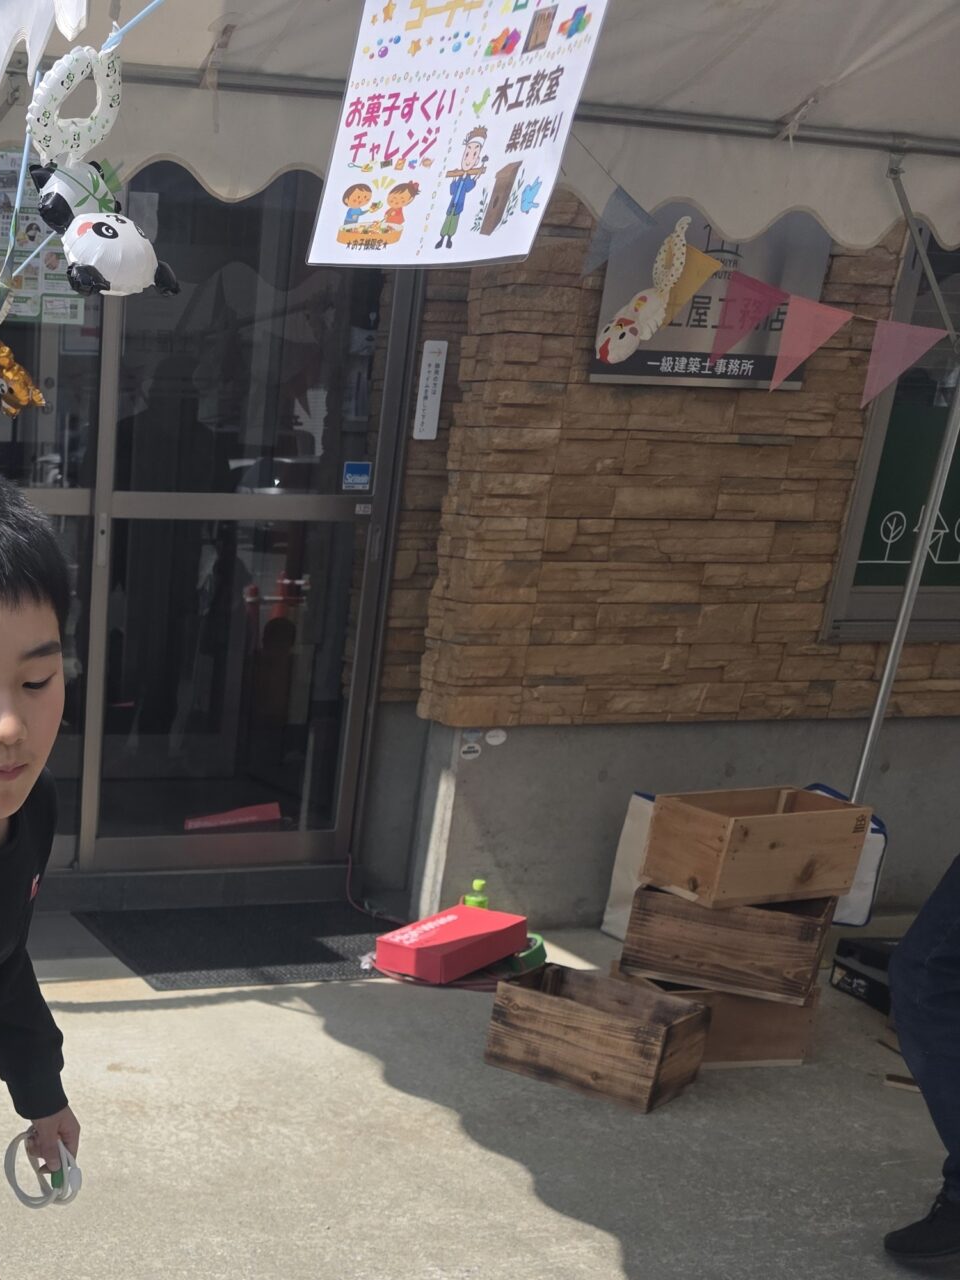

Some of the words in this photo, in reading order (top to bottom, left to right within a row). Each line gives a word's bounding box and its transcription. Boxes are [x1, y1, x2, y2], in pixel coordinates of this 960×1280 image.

[345, 88, 456, 129] お菓子すくい
[491, 65, 565, 115] 木工教室
[349, 127, 441, 163] チャレンジ
[504, 111, 564, 154] 巣箱作り
[647, 356, 755, 377] 一級建築士事務所
